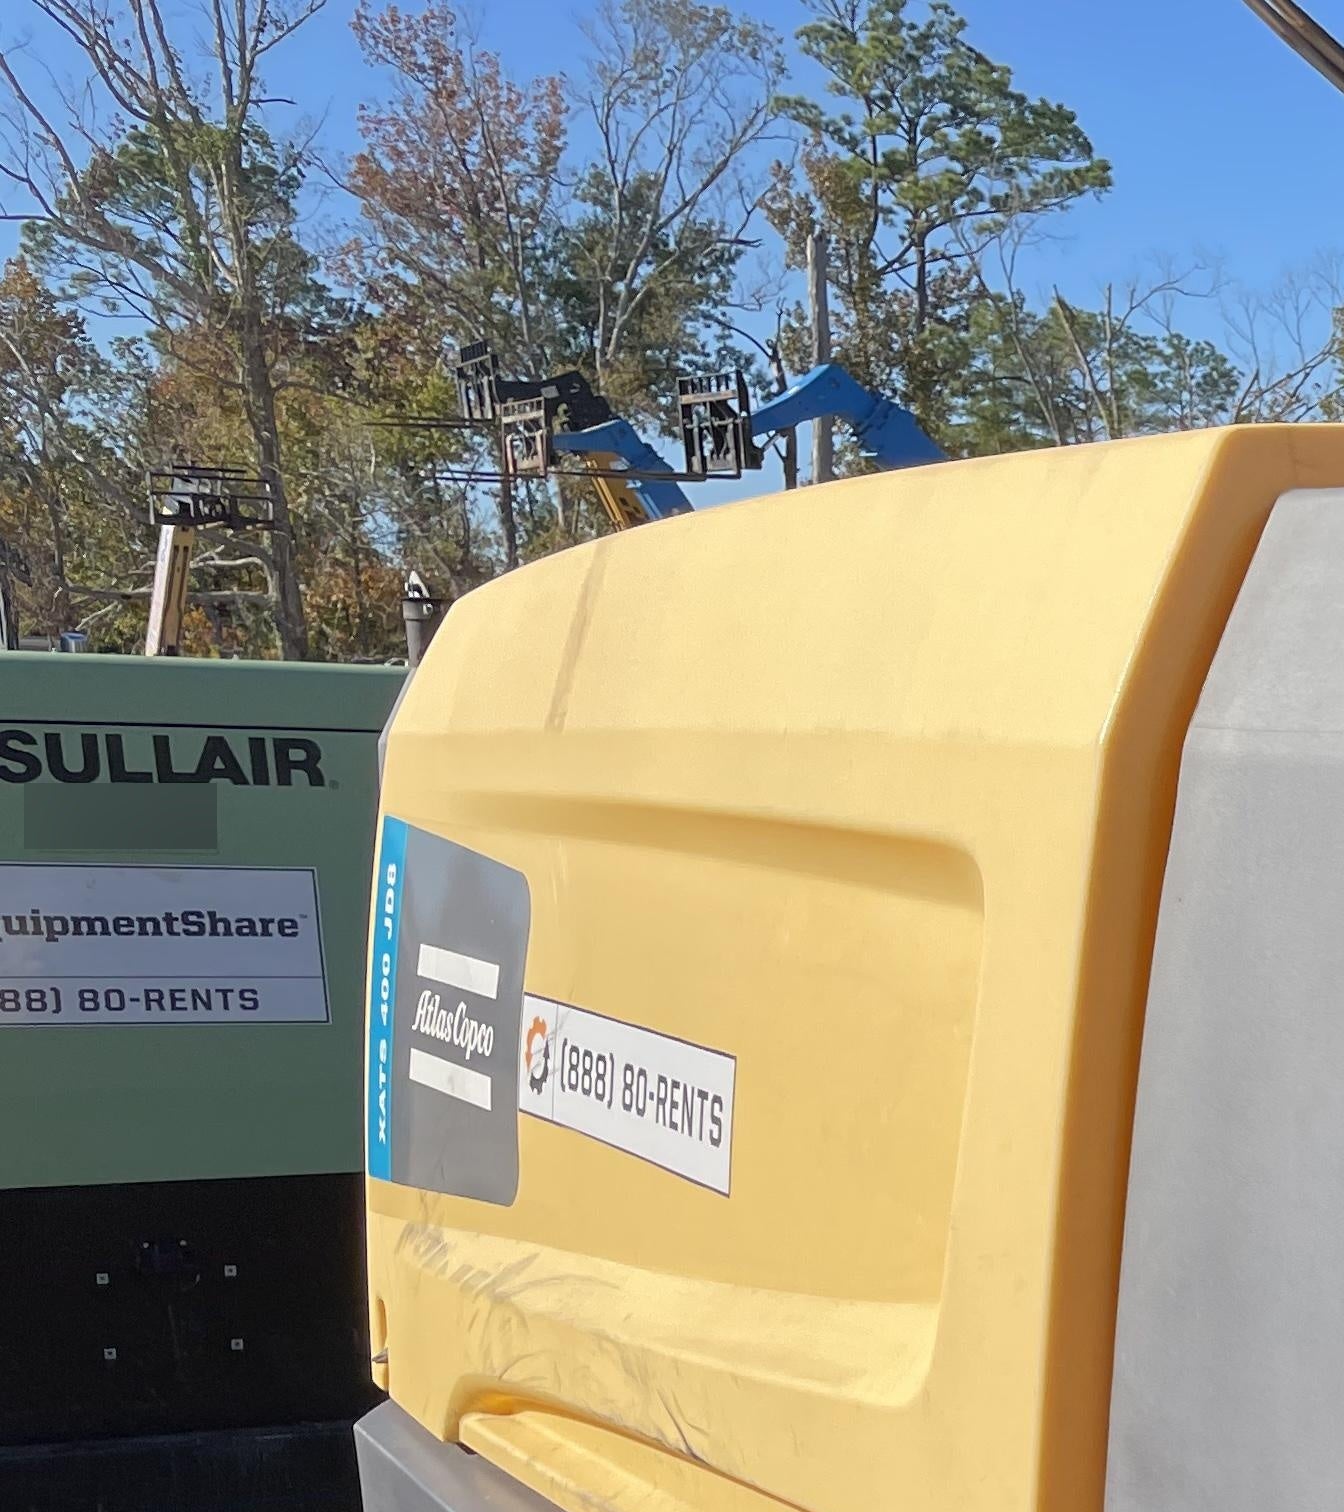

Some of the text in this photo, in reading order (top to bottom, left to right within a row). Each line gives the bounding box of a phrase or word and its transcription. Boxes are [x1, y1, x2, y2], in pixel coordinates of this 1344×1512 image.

[0, 729, 325, 787] SULLAIR
[78, 988, 260, 1012] 80-RENTS
[379, 952, 391, 1027] 400
[376, 1037, 388, 1145] XATS
[560, 1037, 723, 1148] (888) 80-RENTS
